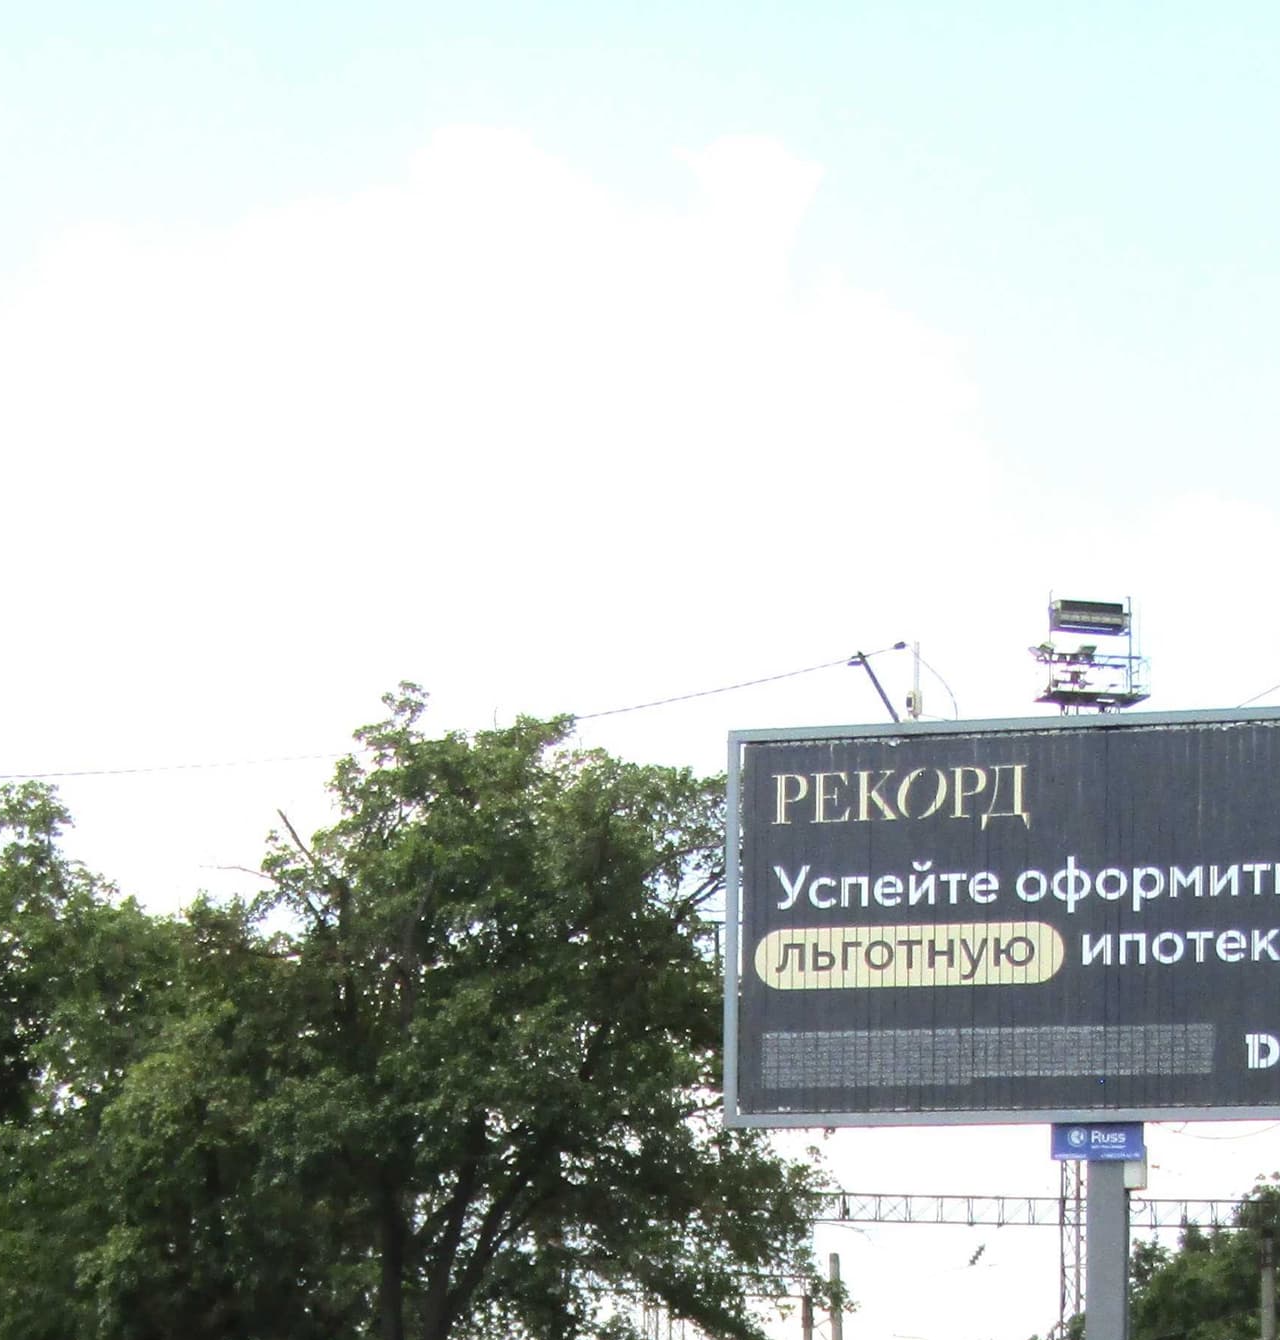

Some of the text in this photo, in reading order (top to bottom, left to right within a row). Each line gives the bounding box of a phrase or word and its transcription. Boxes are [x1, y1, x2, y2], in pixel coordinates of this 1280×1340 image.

[771, 765, 1030, 830] РЕКОРД
[773, 861, 999, 910] Успейте
[775, 935, 1036, 979] льготную
[1091, 1130, 1126, 1143] Russ
